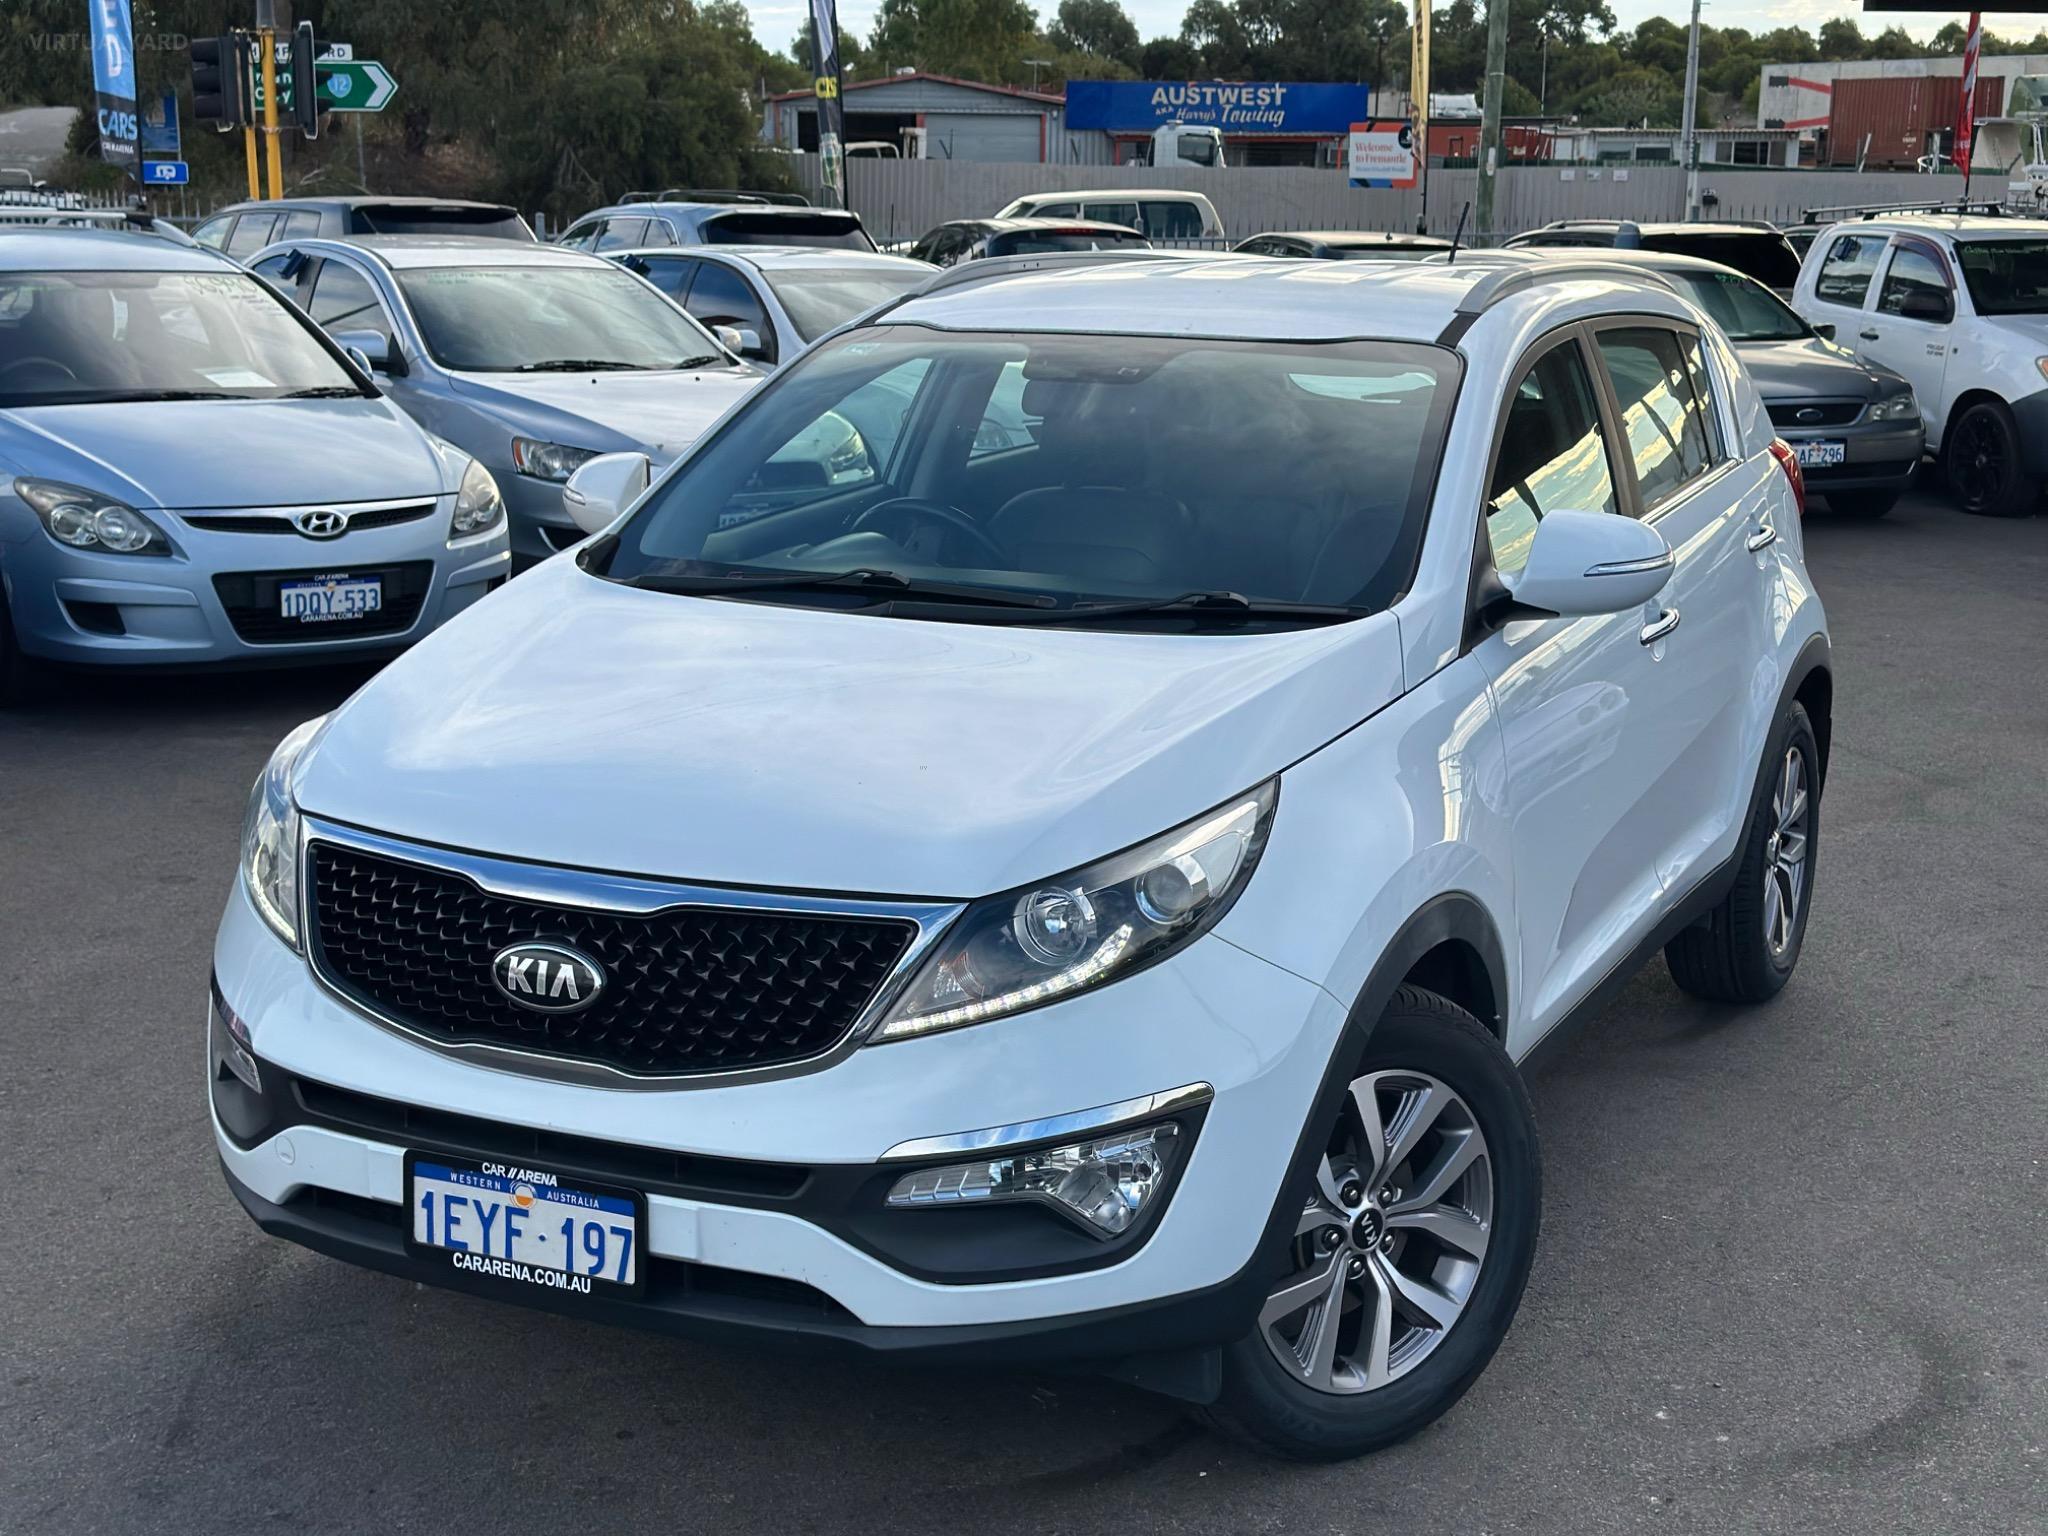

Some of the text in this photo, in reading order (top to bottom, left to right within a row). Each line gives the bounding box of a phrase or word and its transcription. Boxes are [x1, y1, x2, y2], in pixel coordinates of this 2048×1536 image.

[255, 86, 291, 104] Cy
[333, 76, 348, 91] 12
[1151, 86, 1287, 106] AUSTWEST
[98, 108, 138, 141] CARS
[1221, 104, 1286, 128] Towing
[507, 955, 580, 1000] KIA
[482, 1162, 506, 1177] CAR
[450, 1171, 600, 1209] WESTERN AUSTRALIA
[452, 1252, 592, 1294] CARARENA.COM.AU
